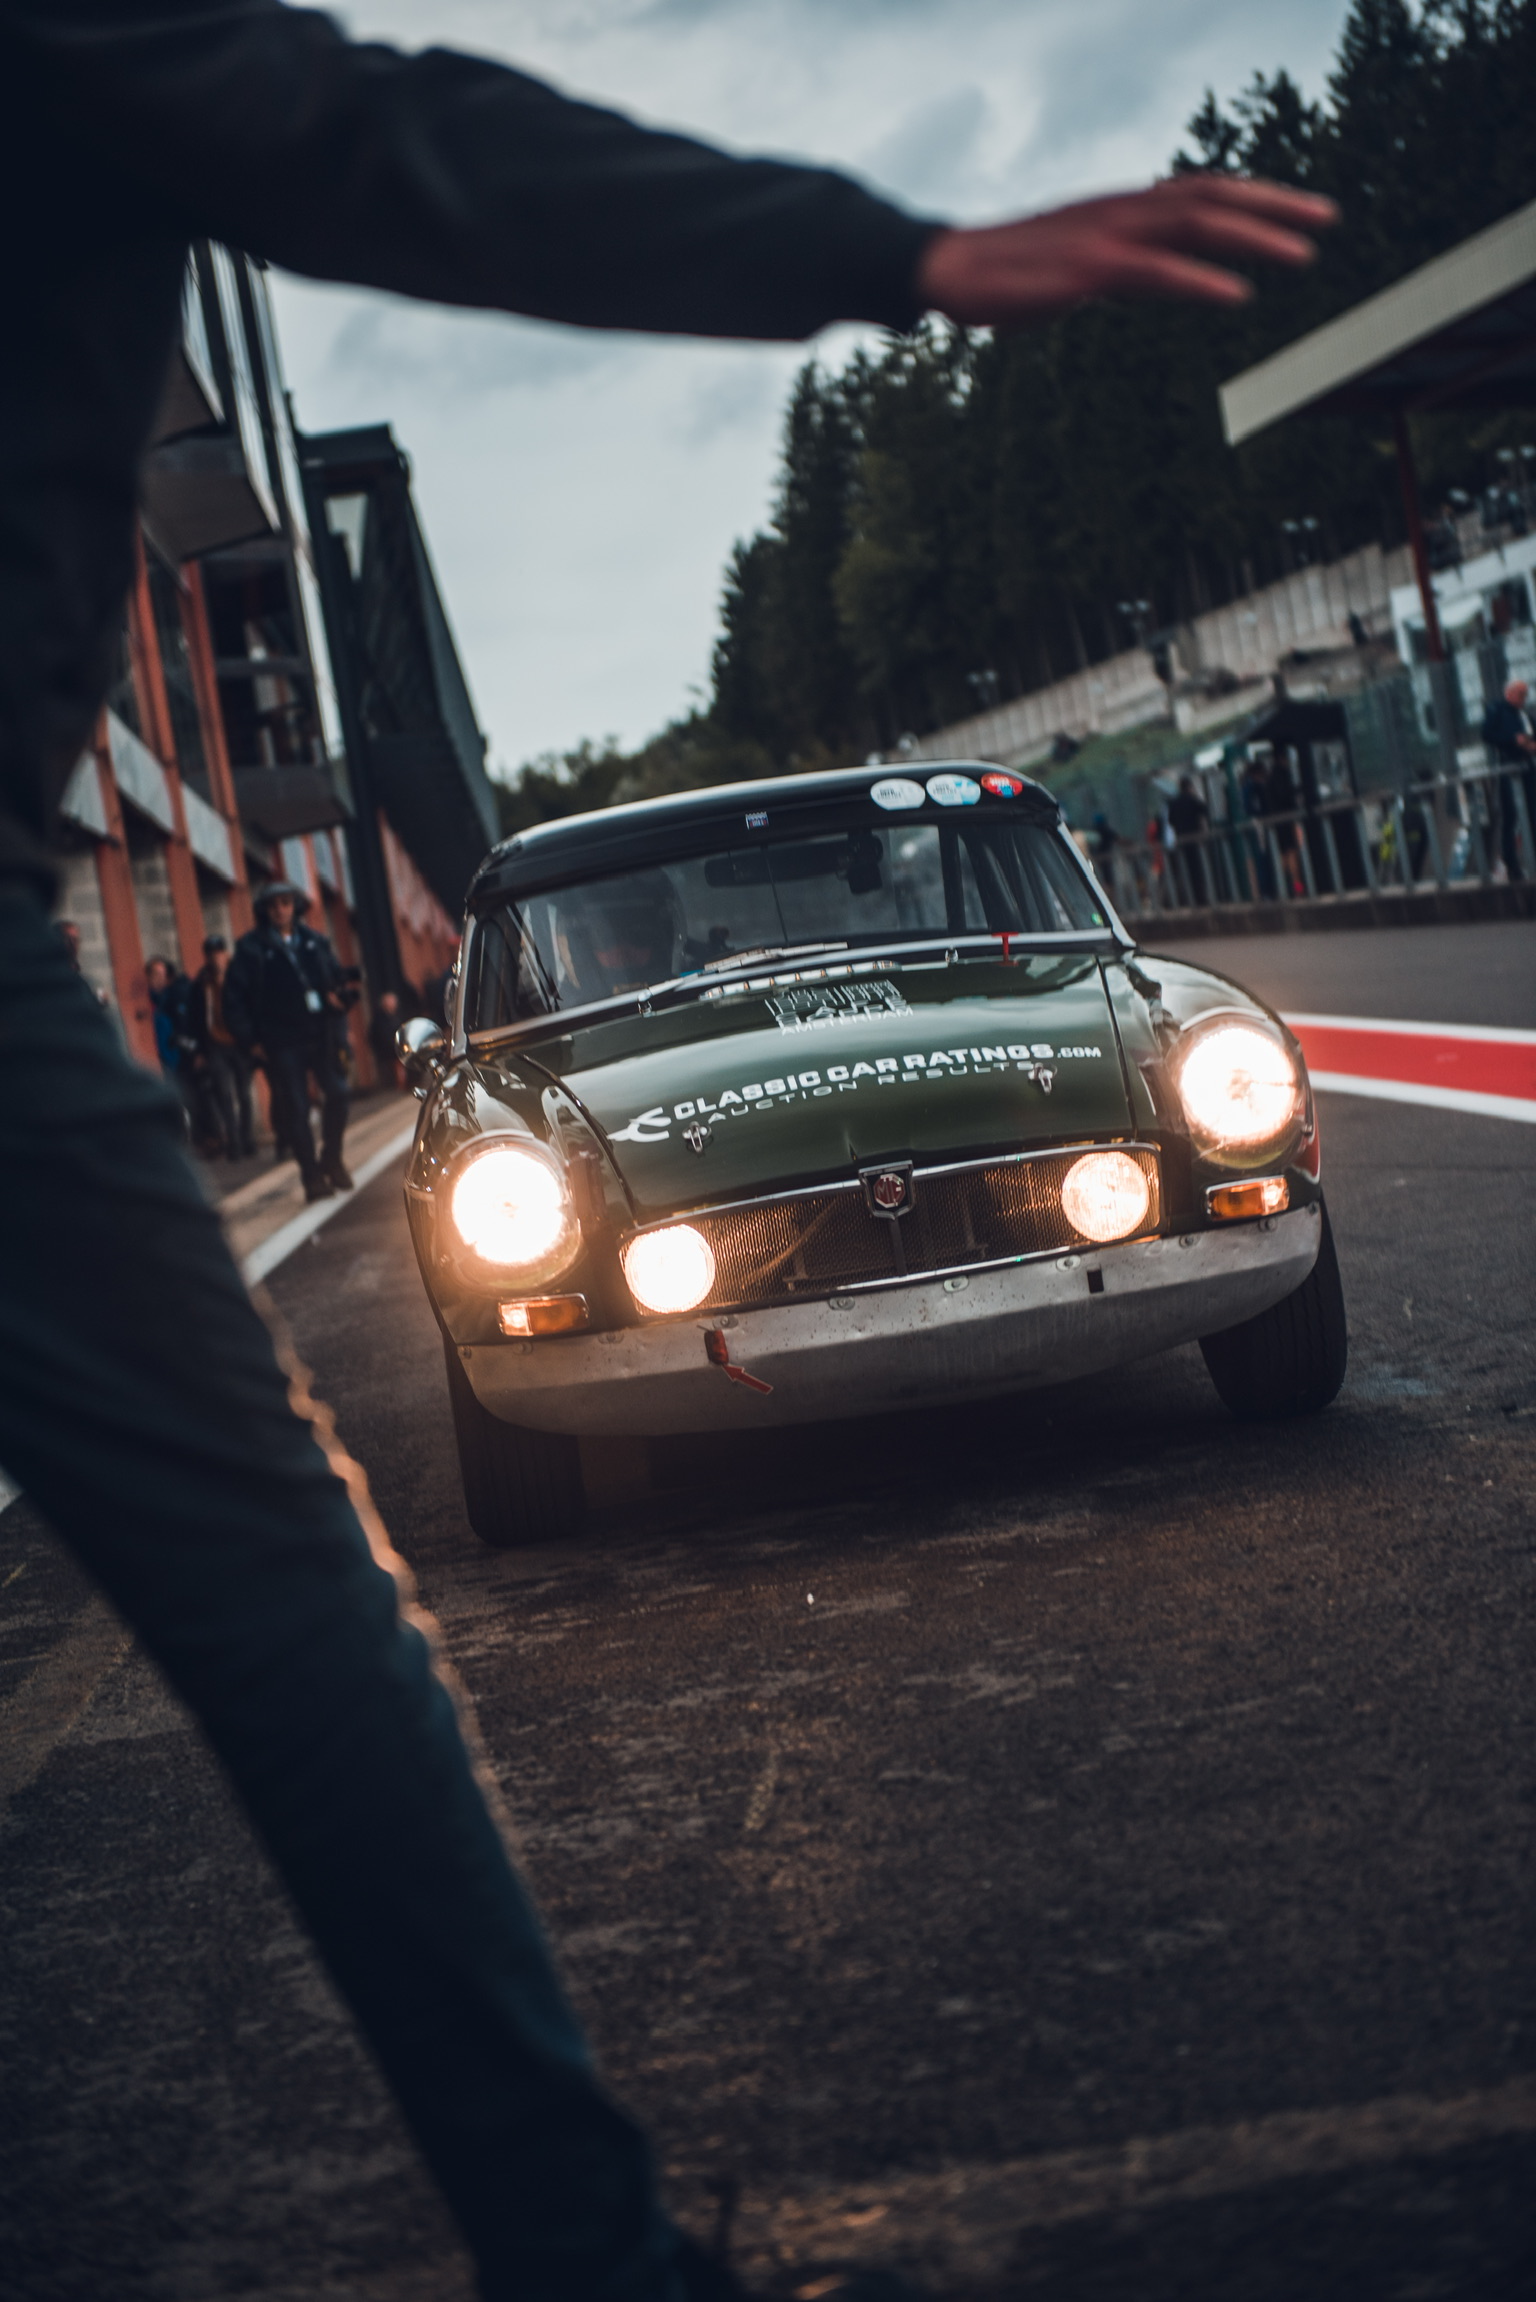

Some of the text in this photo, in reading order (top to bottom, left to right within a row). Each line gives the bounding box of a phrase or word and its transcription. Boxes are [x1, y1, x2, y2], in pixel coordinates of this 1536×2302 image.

[781, 1004, 914, 1036] AMSTERDAM
[674, 1070, 821, 1120] CLASSIC
[827, 1057, 899, 1083] CAR
[708, 1060, 1034, 1124] AUCTION RESULTS
